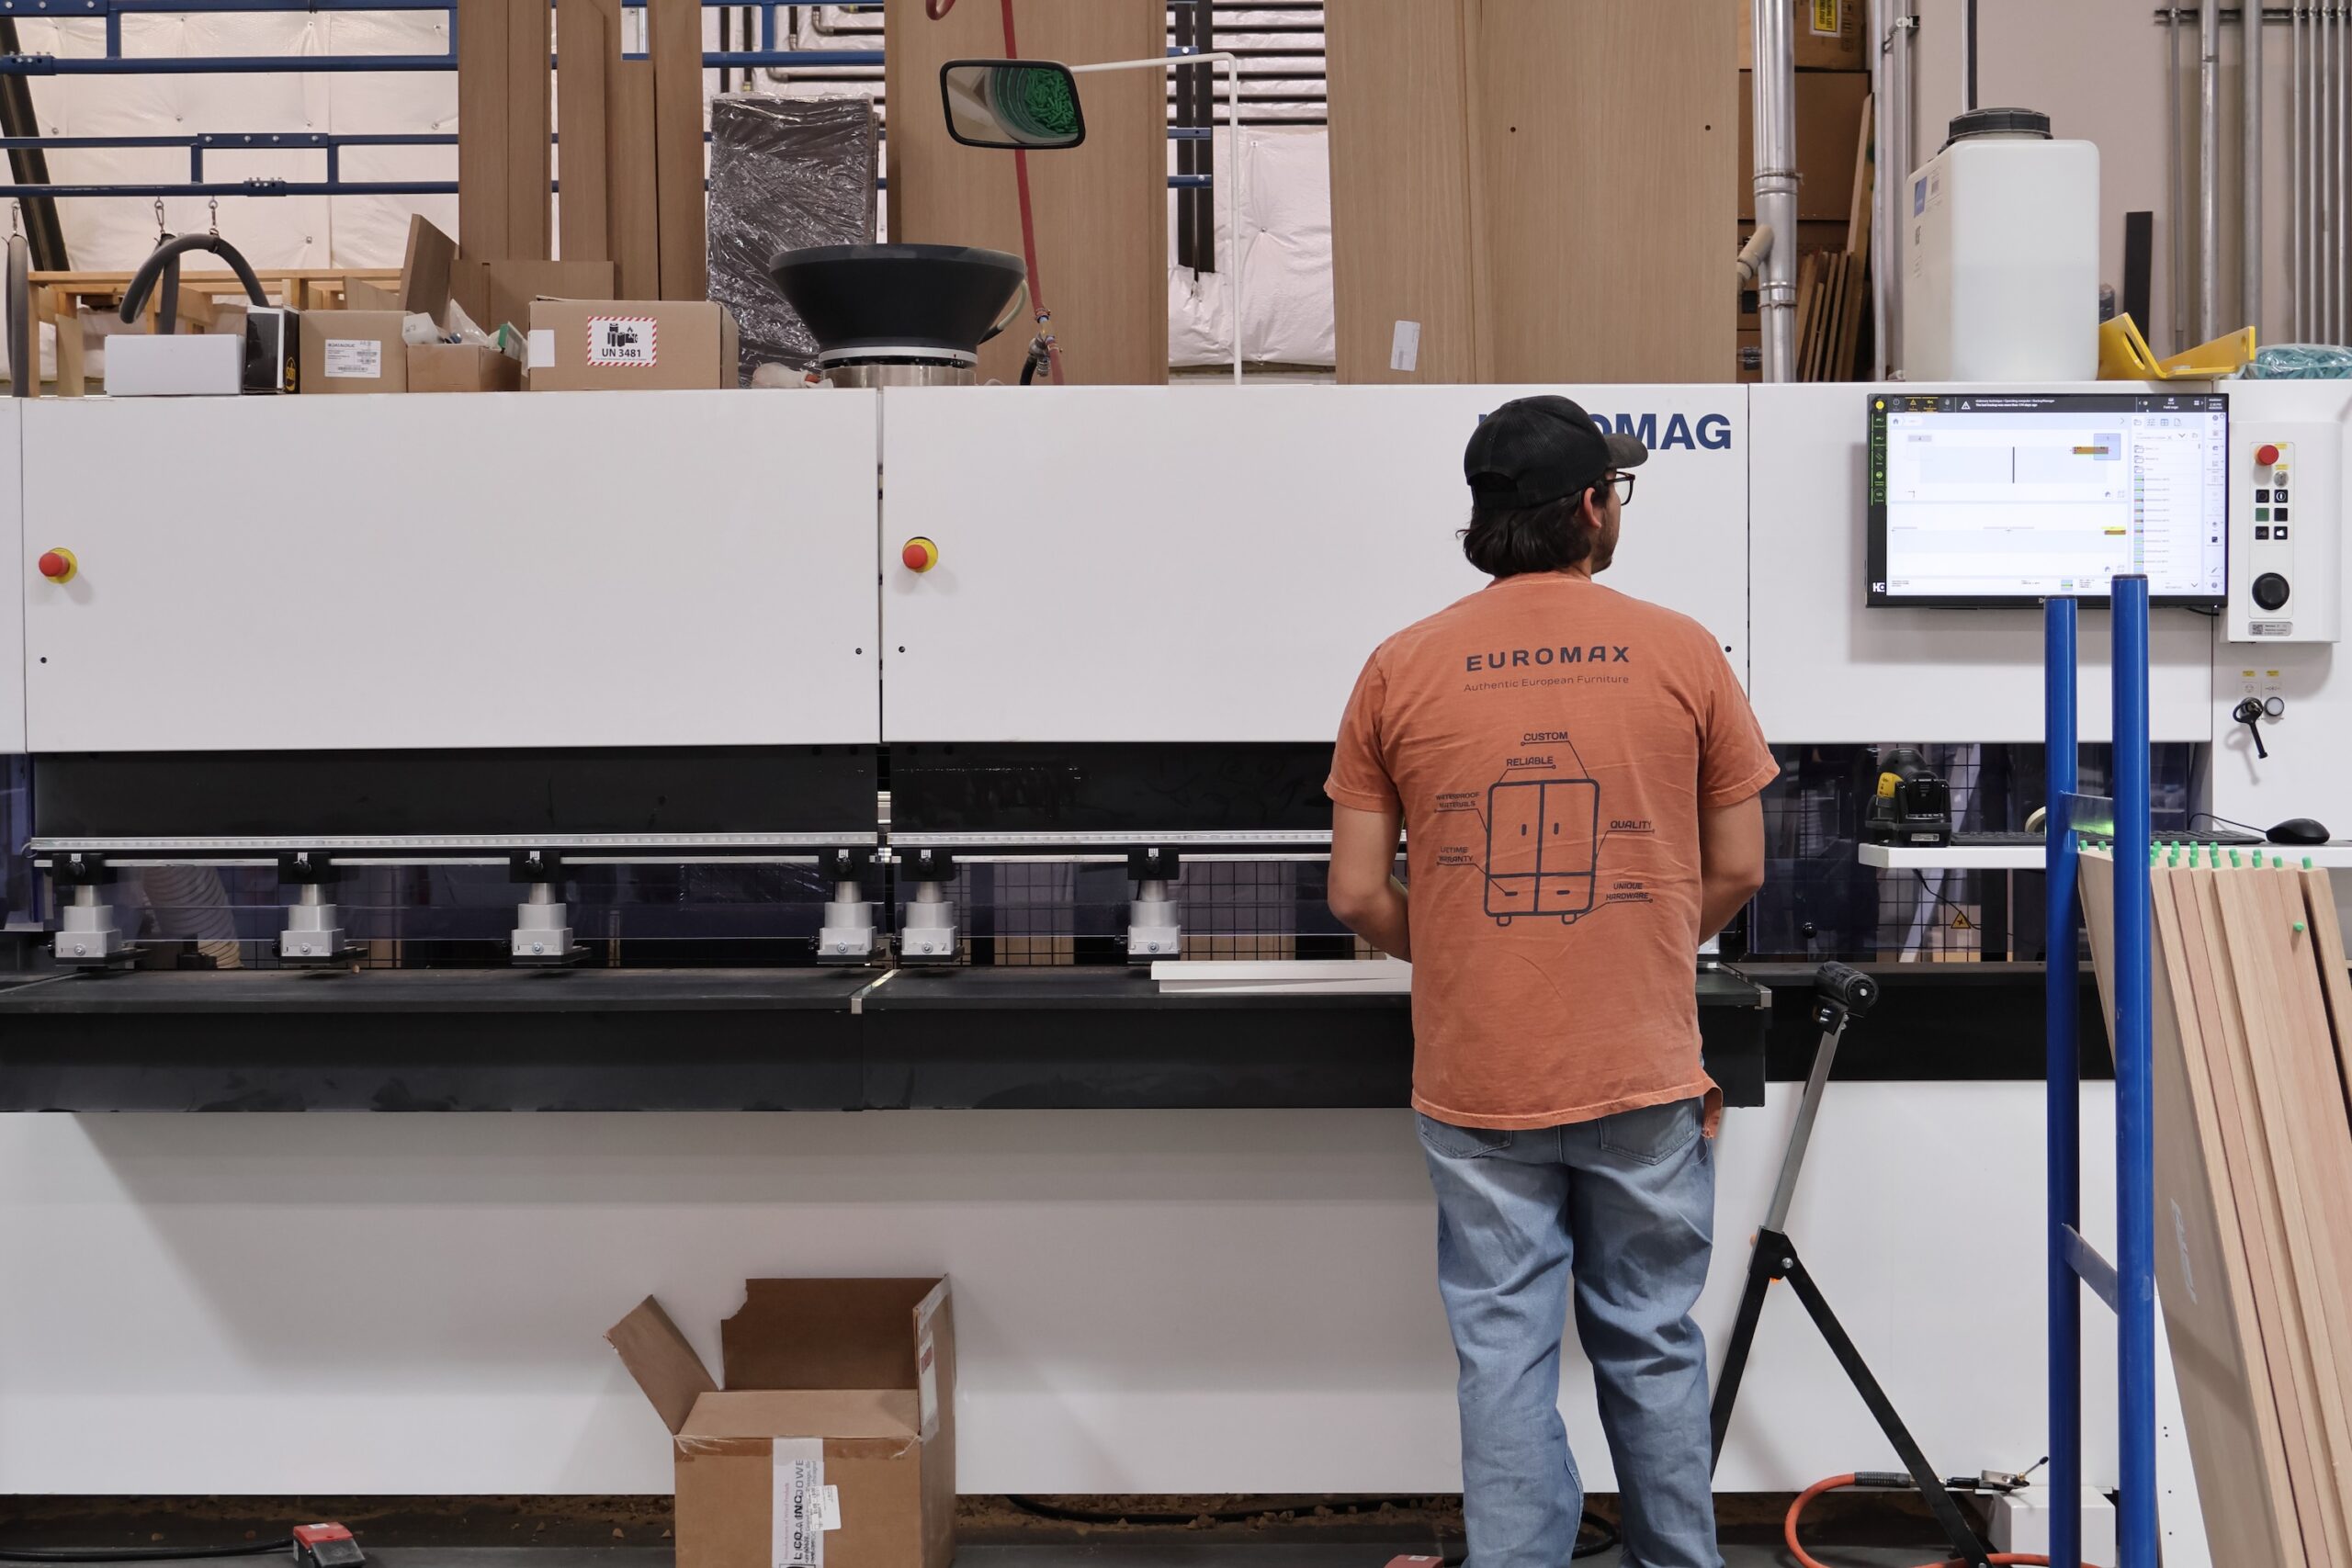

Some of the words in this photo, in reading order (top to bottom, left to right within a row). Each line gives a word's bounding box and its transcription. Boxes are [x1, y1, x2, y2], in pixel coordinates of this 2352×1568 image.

[602, 348, 616, 357] UN
[618, 348, 641, 358] 3481
[1589, 413, 1731, 450] MAG
[1466, 646, 1630, 671] EUROMAX
[1464, 680, 1519, 692] Authentic
[1521, 676, 1574, 687] European
[1577, 675, 1629, 683] Furniture
[1523, 731, 1568, 741] CUSTOM
[1506, 756, 1554, 766] RELIABLE
[1610, 820, 1652, 829] QUALITY
[1606, 892, 1649, 900] HARDWARE
